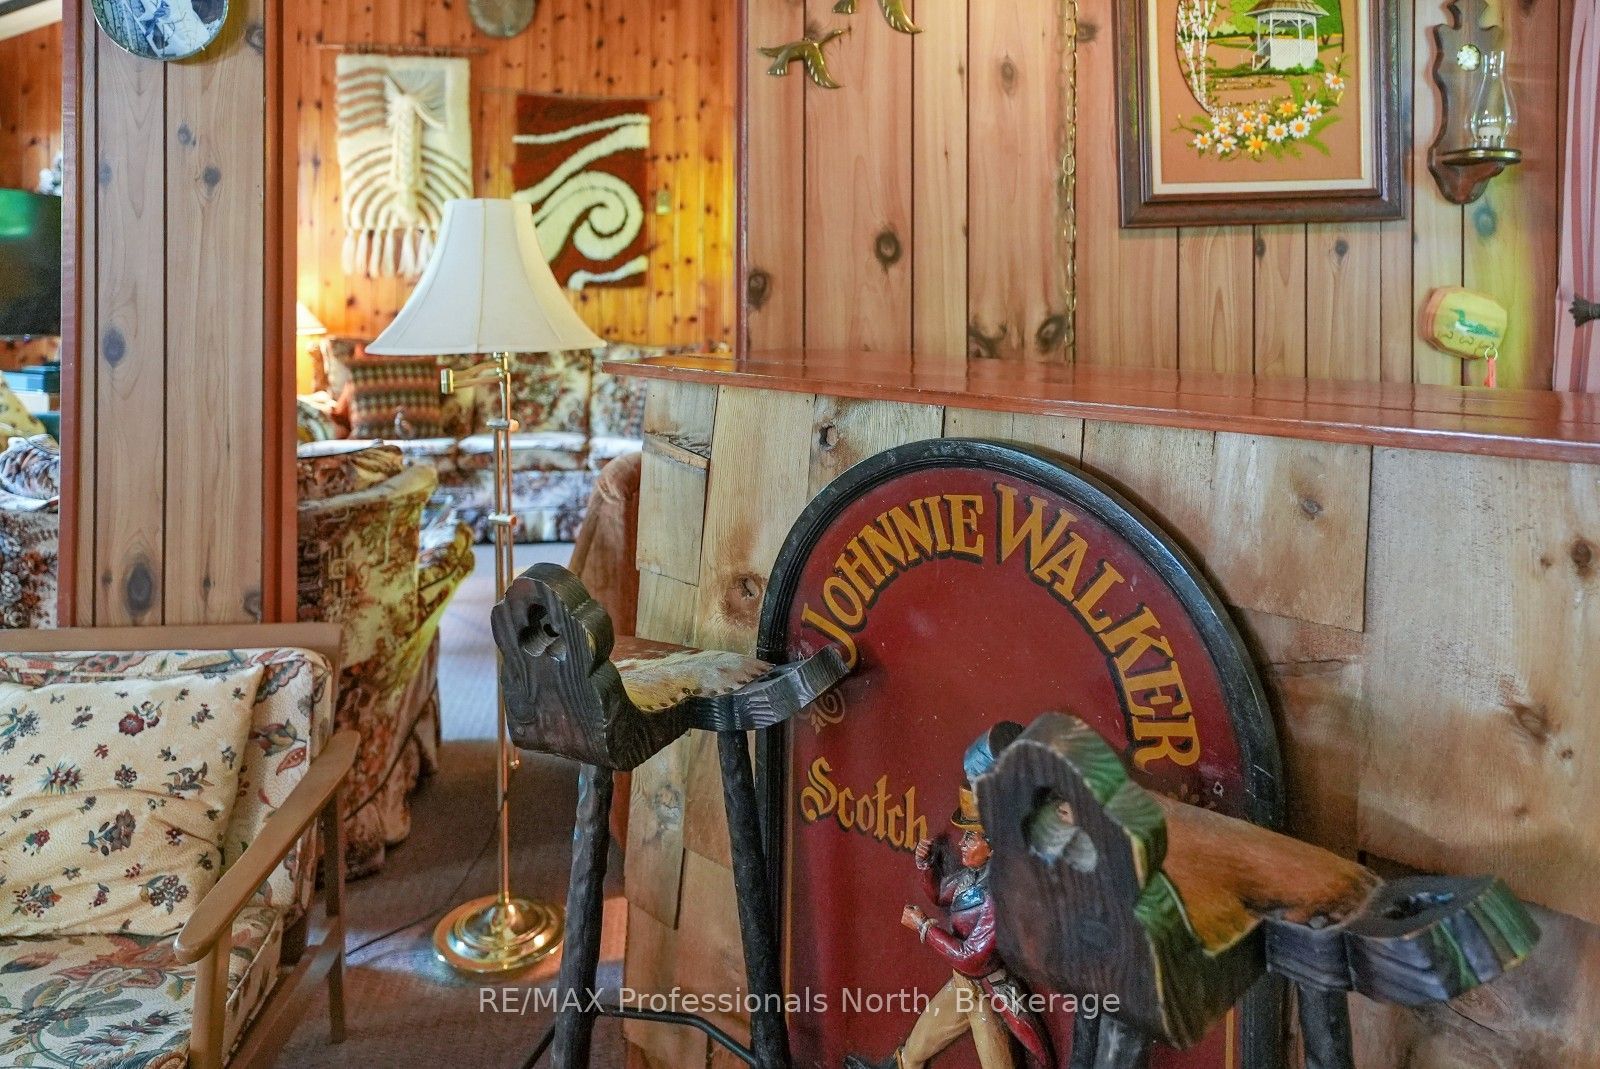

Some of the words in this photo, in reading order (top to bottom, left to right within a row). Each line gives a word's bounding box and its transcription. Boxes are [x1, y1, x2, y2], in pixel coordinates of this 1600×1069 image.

[801, 494, 985, 670] JOHNNIE
[993, 482, 1201, 768] WALKER
[800, 756, 928, 851] Scotch
